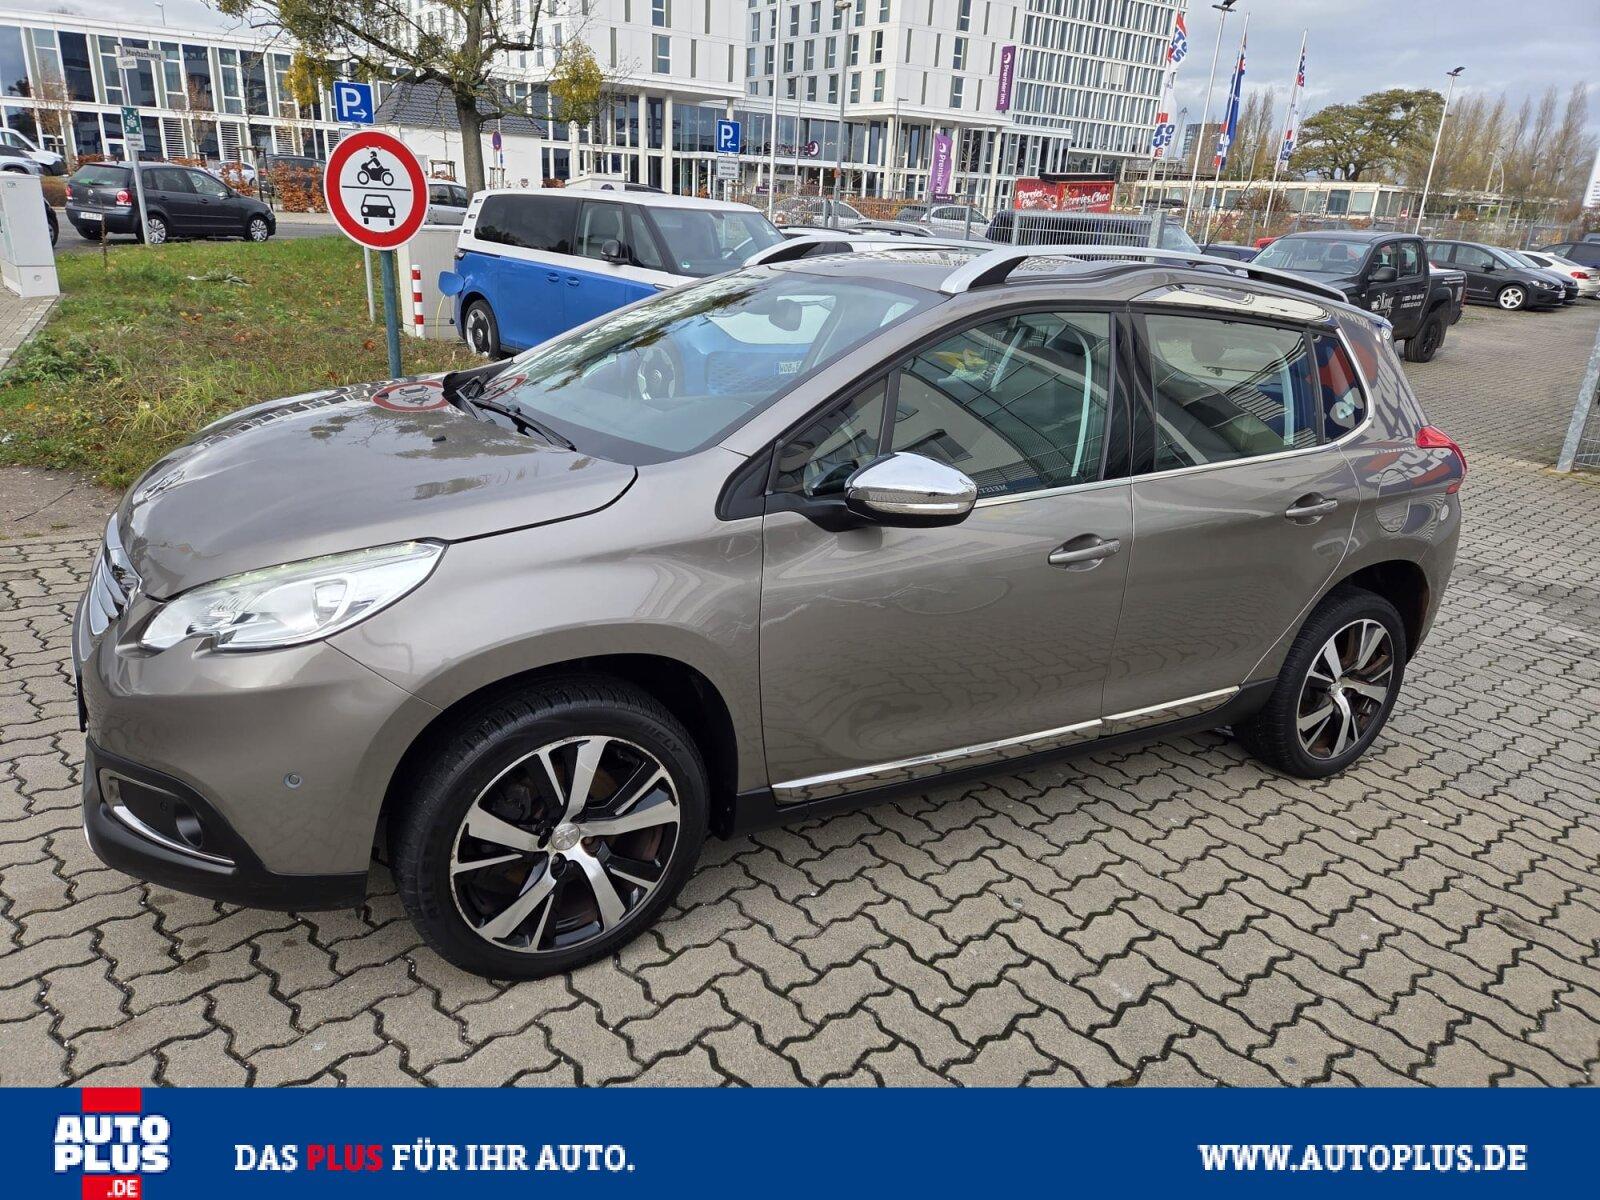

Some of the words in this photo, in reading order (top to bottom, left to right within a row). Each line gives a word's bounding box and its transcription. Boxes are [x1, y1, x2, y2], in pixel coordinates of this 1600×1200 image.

[1001, 64, 1010, 92] Premier
[341, 87, 361, 117] P
[721, 124, 734, 148] P
[935, 154, 947, 185] Premier
